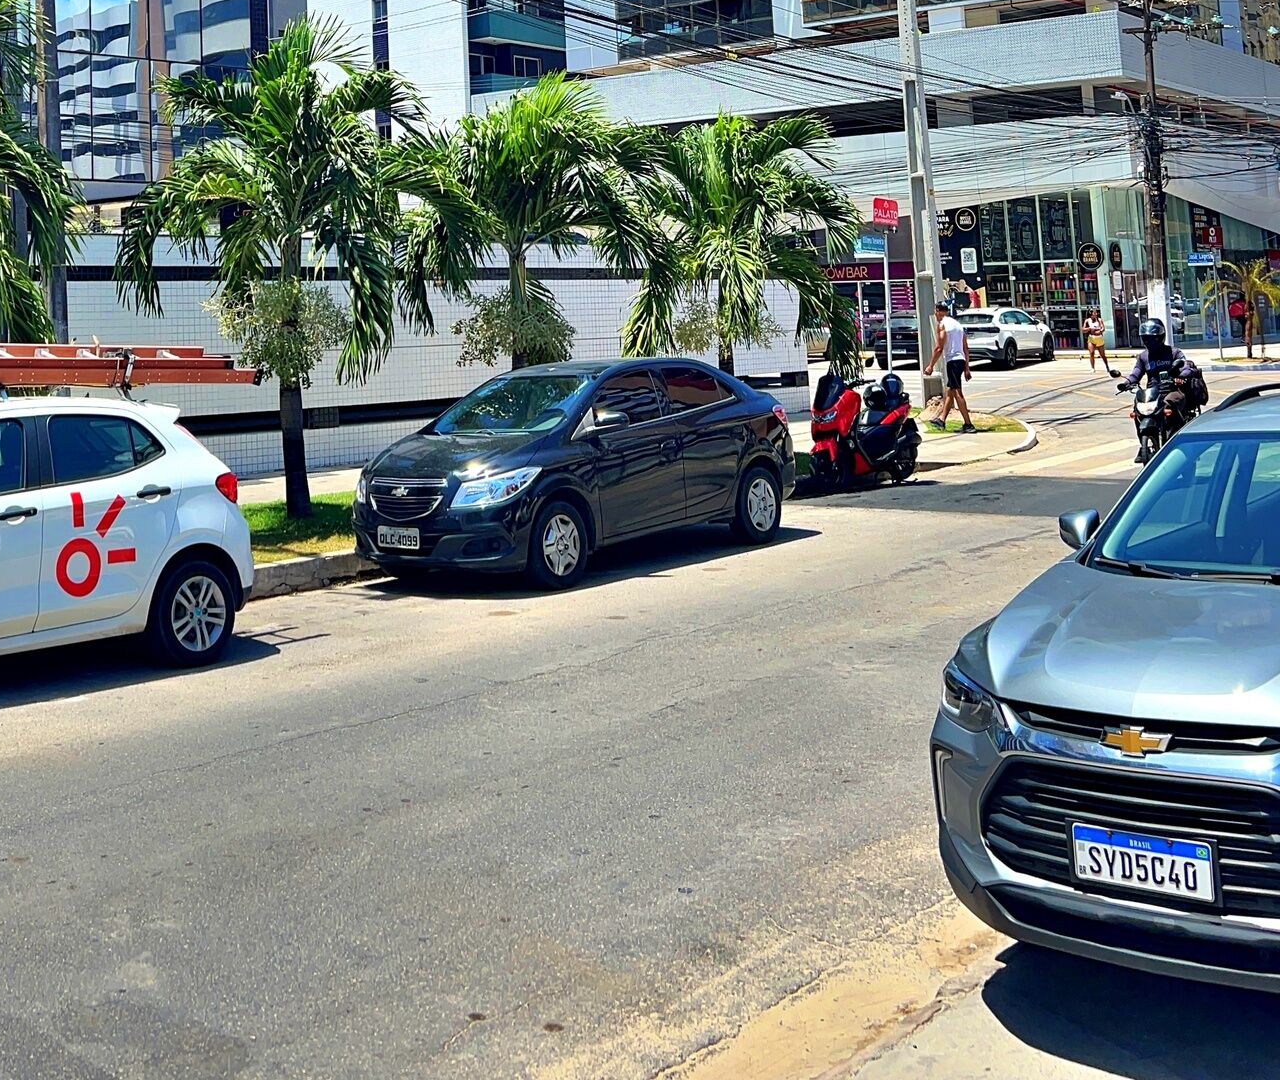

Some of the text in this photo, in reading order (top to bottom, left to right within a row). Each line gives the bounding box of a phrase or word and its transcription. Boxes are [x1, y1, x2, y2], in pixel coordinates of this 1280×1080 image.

[874, 208, 898, 220] PALATO
[846, 266, 868, 278] BAR
[1129, 839, 1152, 850] BRASIL
[1079, 864, 1087, 875] BR
[1088, 846, 1197, 891] SYD5C40
